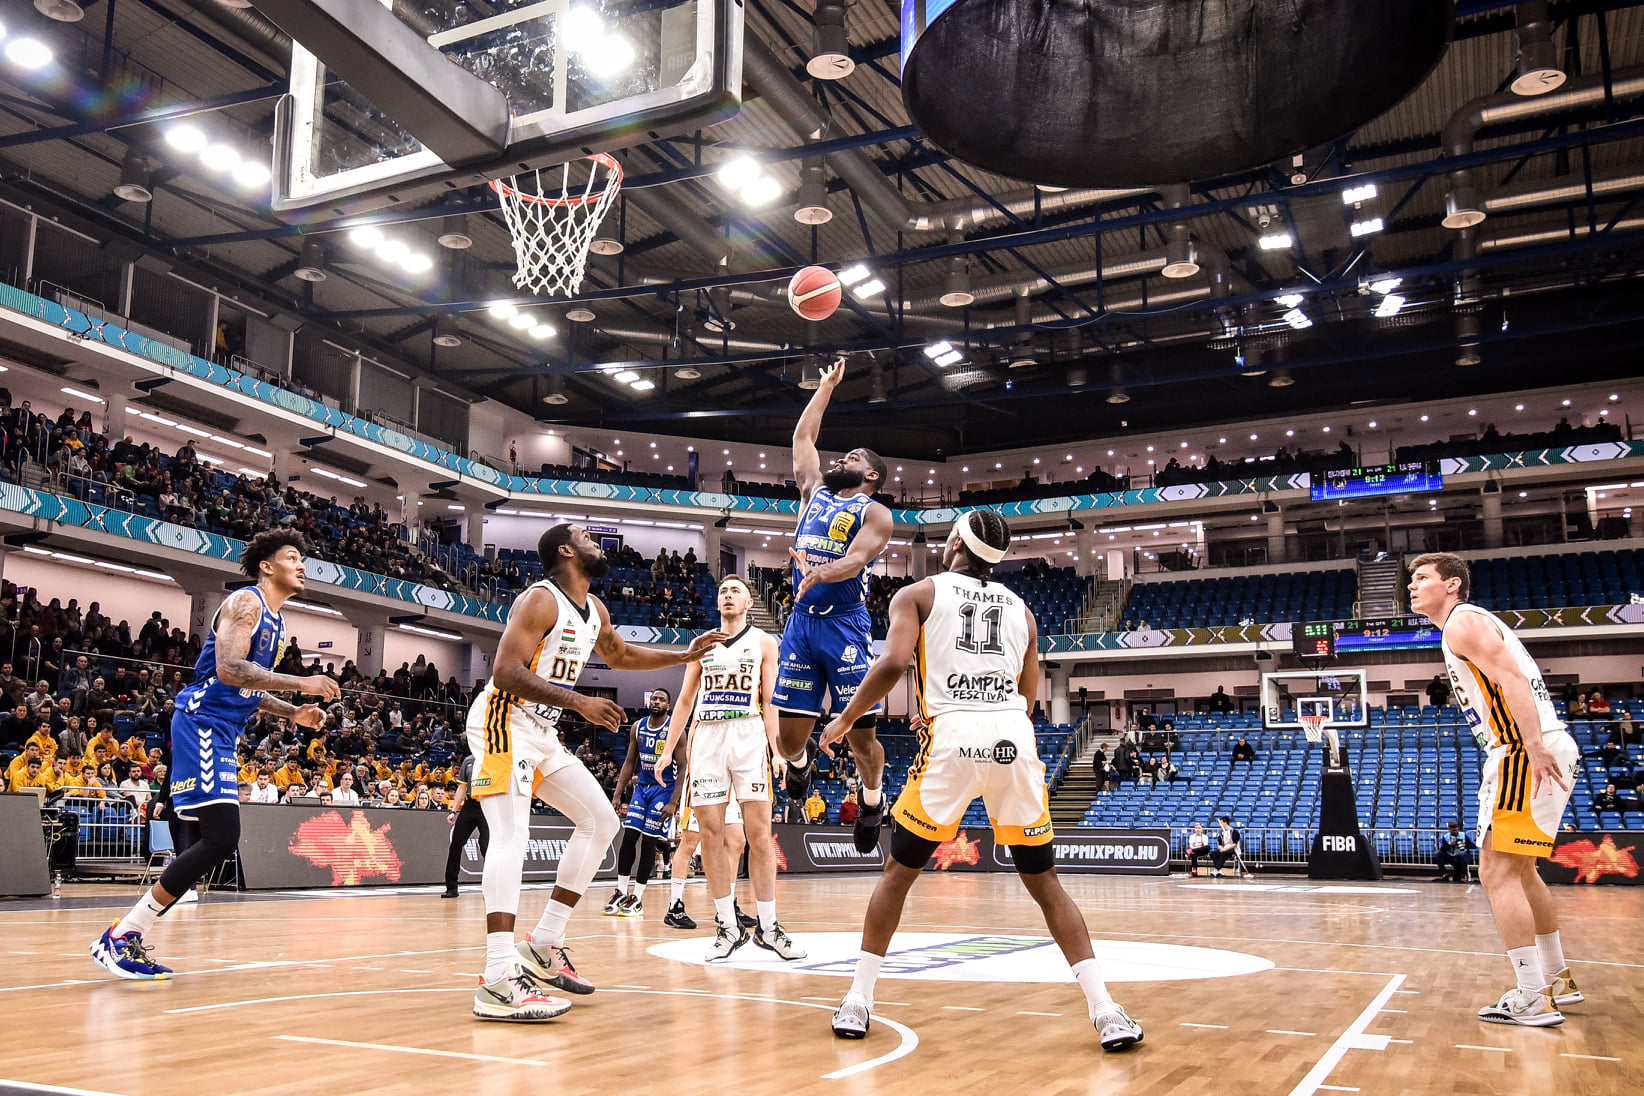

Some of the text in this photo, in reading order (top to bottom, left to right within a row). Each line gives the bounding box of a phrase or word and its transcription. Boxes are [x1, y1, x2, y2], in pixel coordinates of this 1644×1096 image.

[953, 586, 1013, 606] THAMES
[955, 601, 1005, 656] 11
[1347, 621, 1359, 629] 21
[1391, 618, 1404, 627] 21
[1363, 628, 1390, 637] 9:12
[550, 656, 583, 682] DE
[740, 663, 754, 674] 57
[704, 673, 753, 691] DEAC
[947, 672, 1014, 694] CAMPUS
[645, 736, 655, 748] 10
[959, 746, 1016, 759] MAG HR
[171, 777, 197, 791] Hertz
[751, 782, 765, 793] 57
[902, 809, 938, 832] Debrecen
[1322, 835, 1356, 851] FIBA
